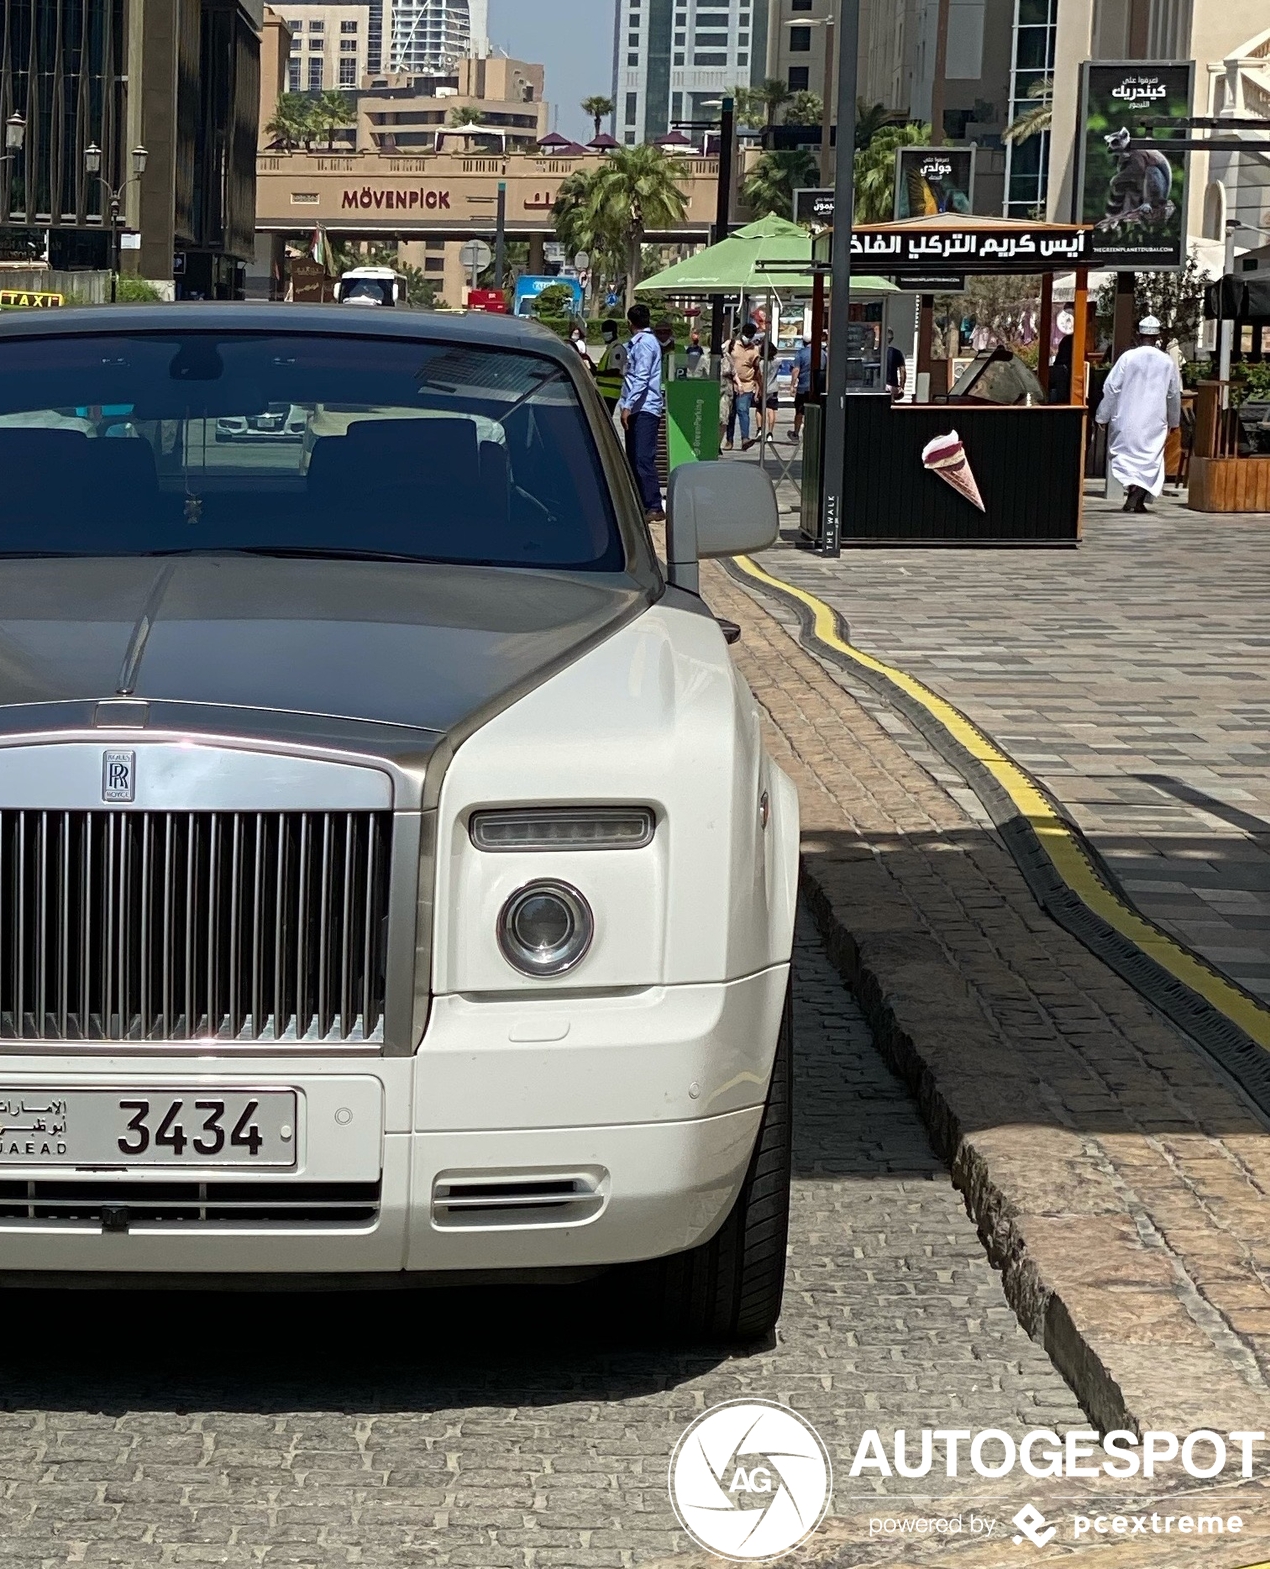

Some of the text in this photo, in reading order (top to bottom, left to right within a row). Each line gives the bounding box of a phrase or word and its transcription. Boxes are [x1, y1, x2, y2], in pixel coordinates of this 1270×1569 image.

[1111, 85, 1167, 101] كيندريك
[919, 162, 952, 176] جولدي
[850, 234, 901, 254] الفاخ
[979, 234, 1036, 257] كريم
[1039, 230, 1086, 258] آيس
[10, 293, 52, 308] TAXI
[826, 495, 835, 550] THE WALK
[117, 1100, 263, 1156] 3434
